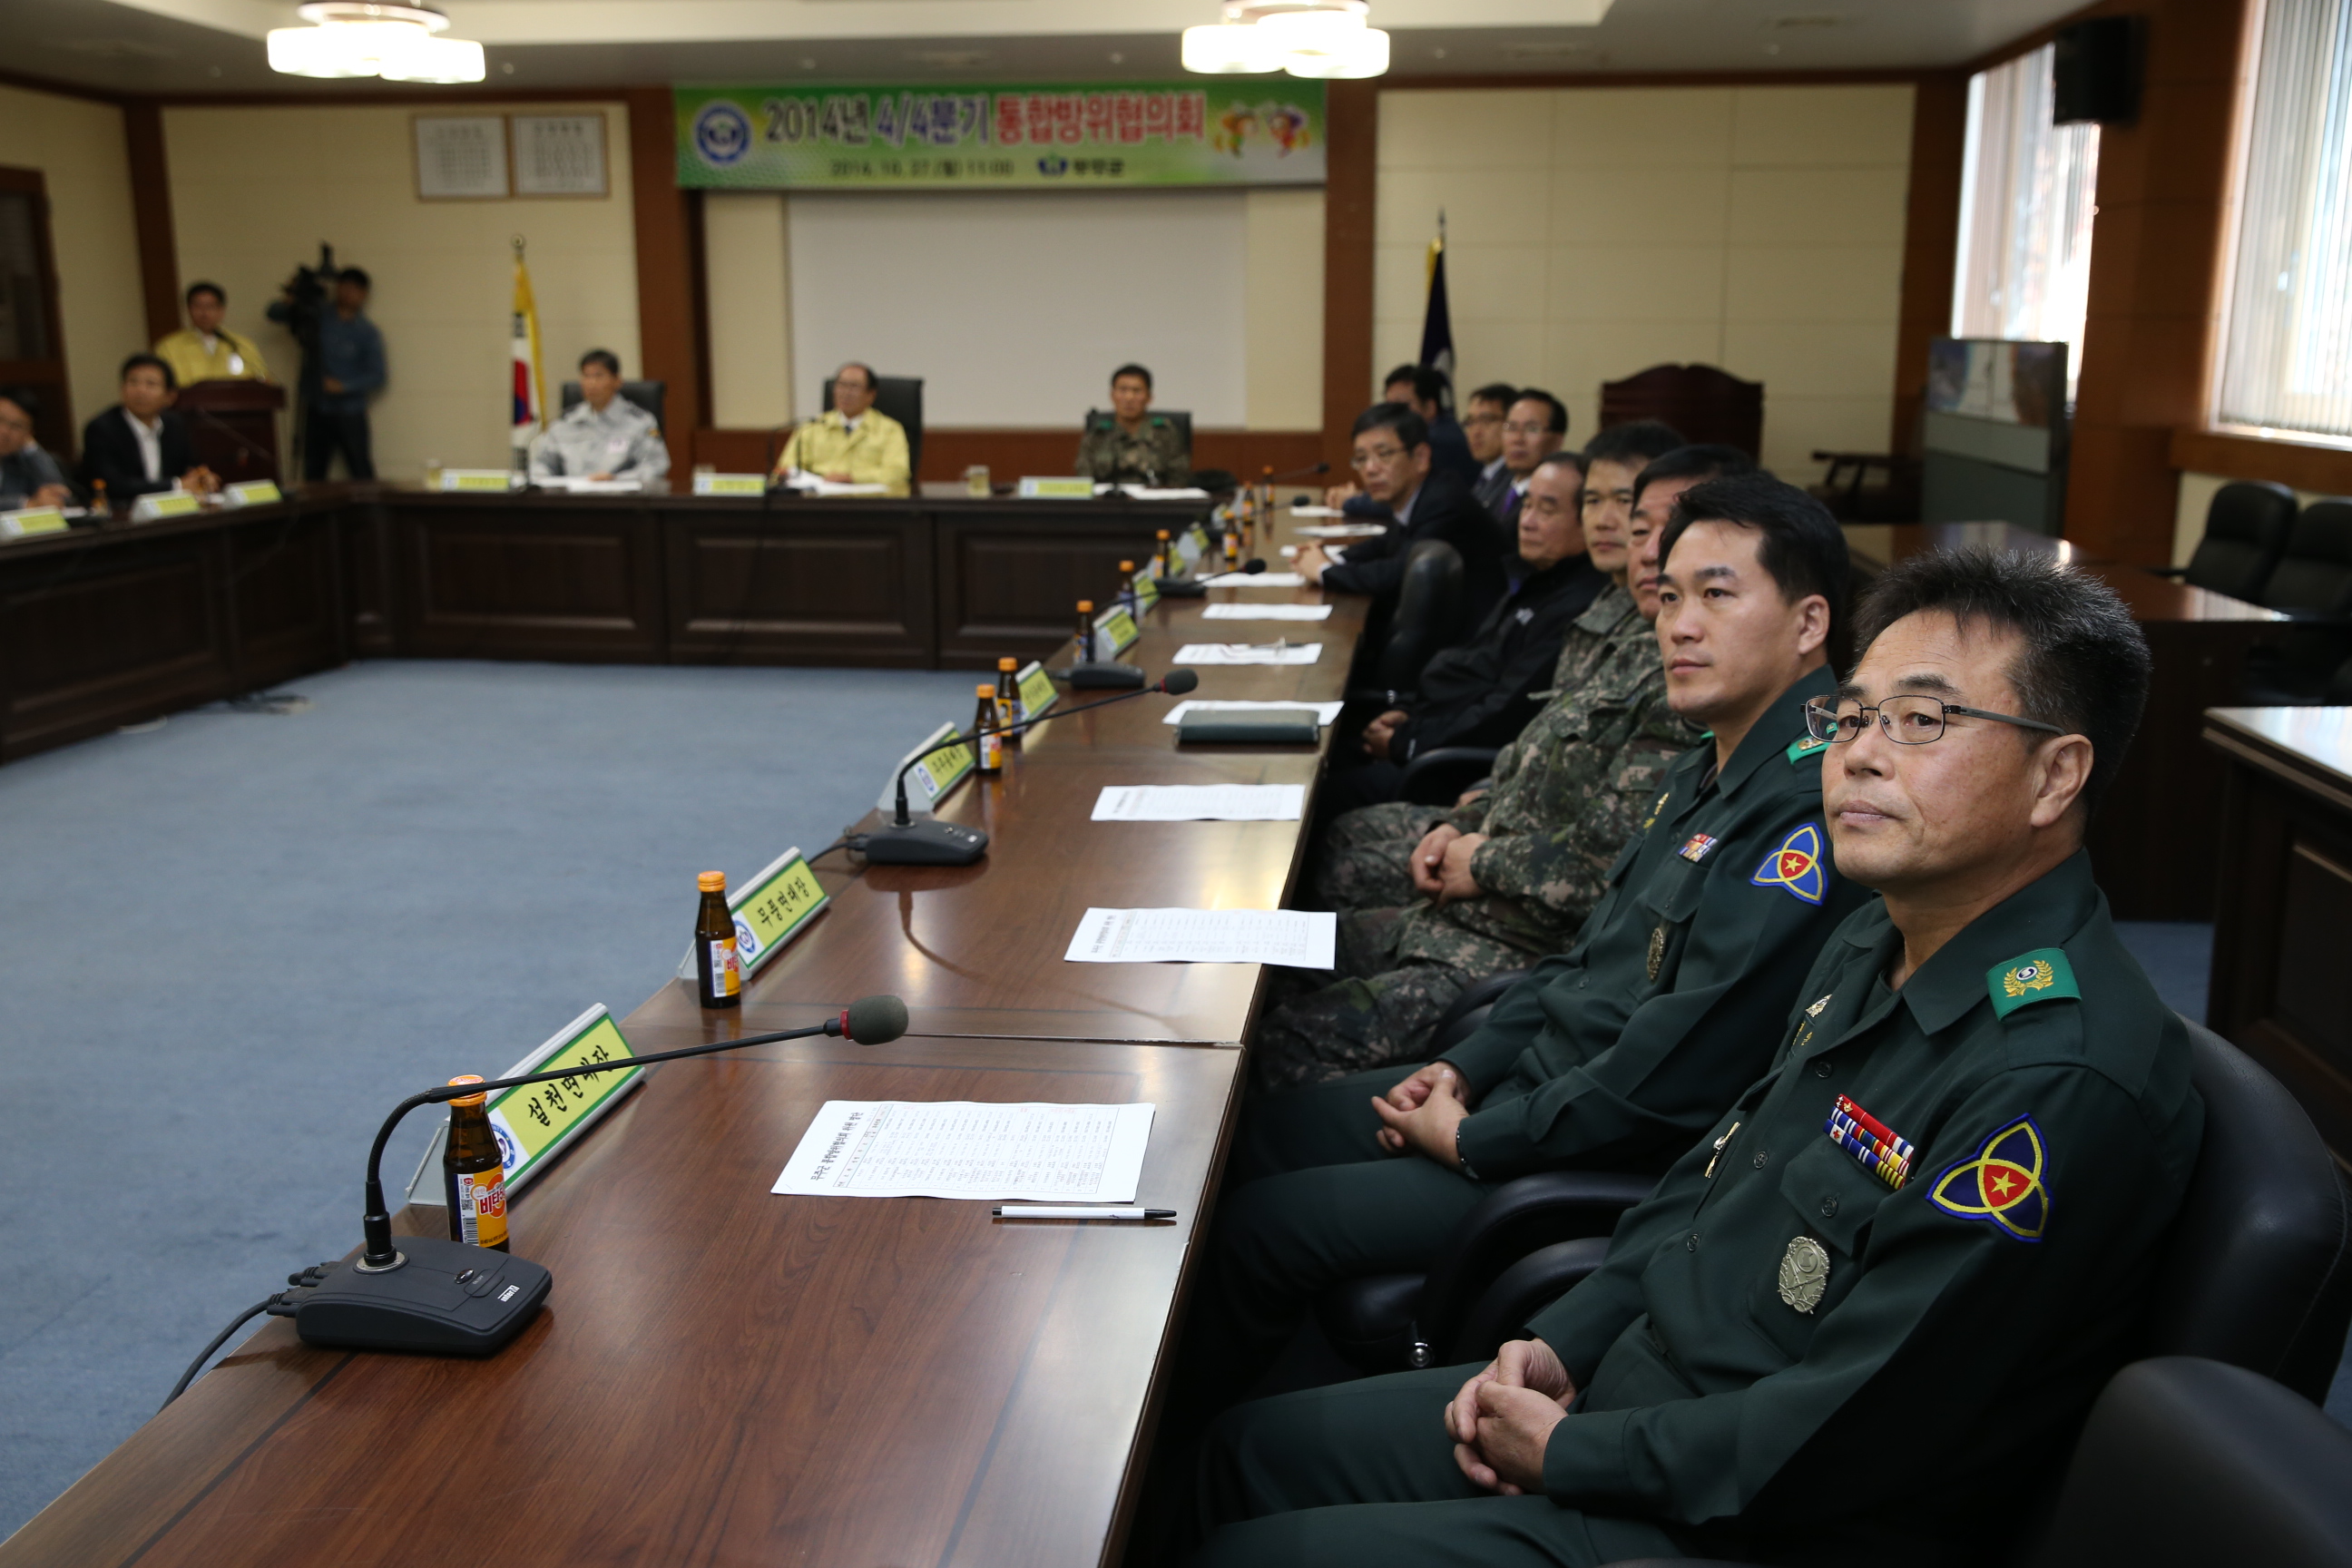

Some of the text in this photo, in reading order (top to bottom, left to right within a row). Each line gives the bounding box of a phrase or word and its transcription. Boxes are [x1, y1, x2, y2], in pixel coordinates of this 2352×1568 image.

[765, 93, 1205, 145] 2014년 4/4분기 통합방위협의회
[758, 877, 810, 927] 무풍면대장
